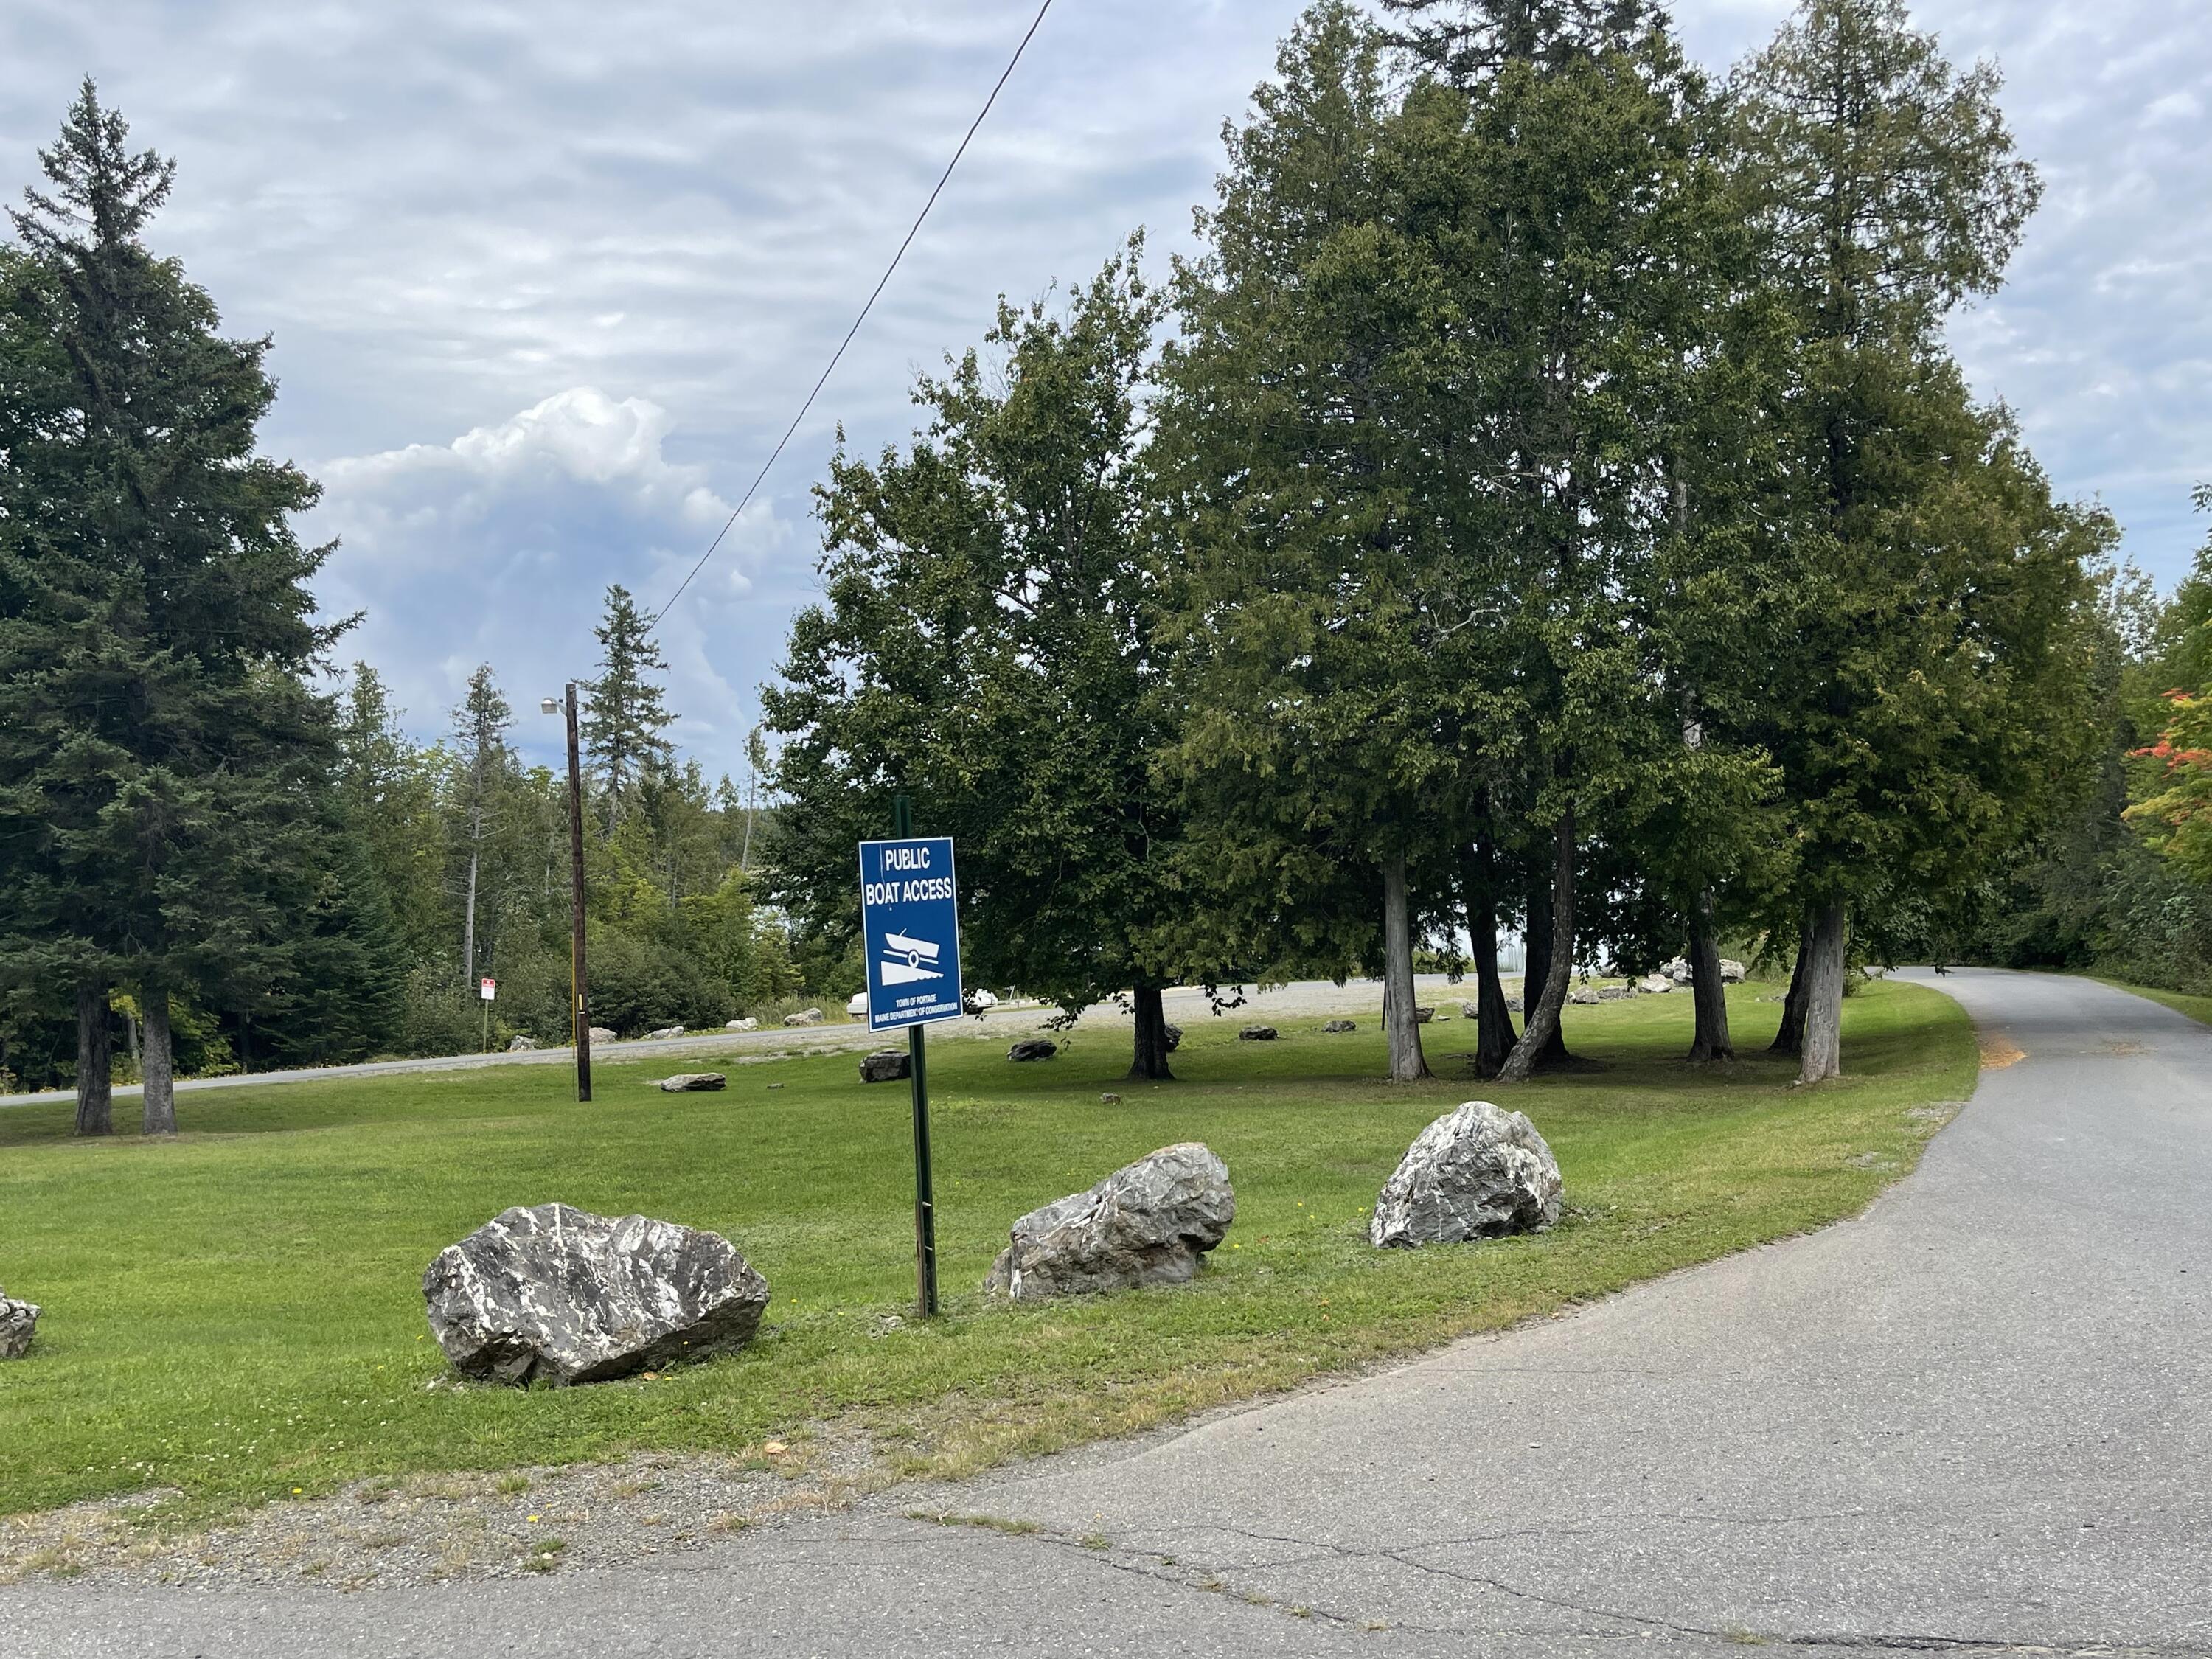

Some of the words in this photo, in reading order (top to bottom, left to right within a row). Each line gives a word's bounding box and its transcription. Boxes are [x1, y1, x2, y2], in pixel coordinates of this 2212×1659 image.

[885, 846, 930, 871] PUBLIC
[866, 882, 900, 906] BOAT
[902, 877, 952, 902] ACCESS
[896, 998, 909, 1007] TOWN
[910, 996, 917, 1006] OF
[917, 994, 936, 1004] PORTAGE
[874, 1012, 890, 1023] MAINE
[919, 1006, 925, 1016] OF
[925, 1002, 958, 1015] CONSERVATION
